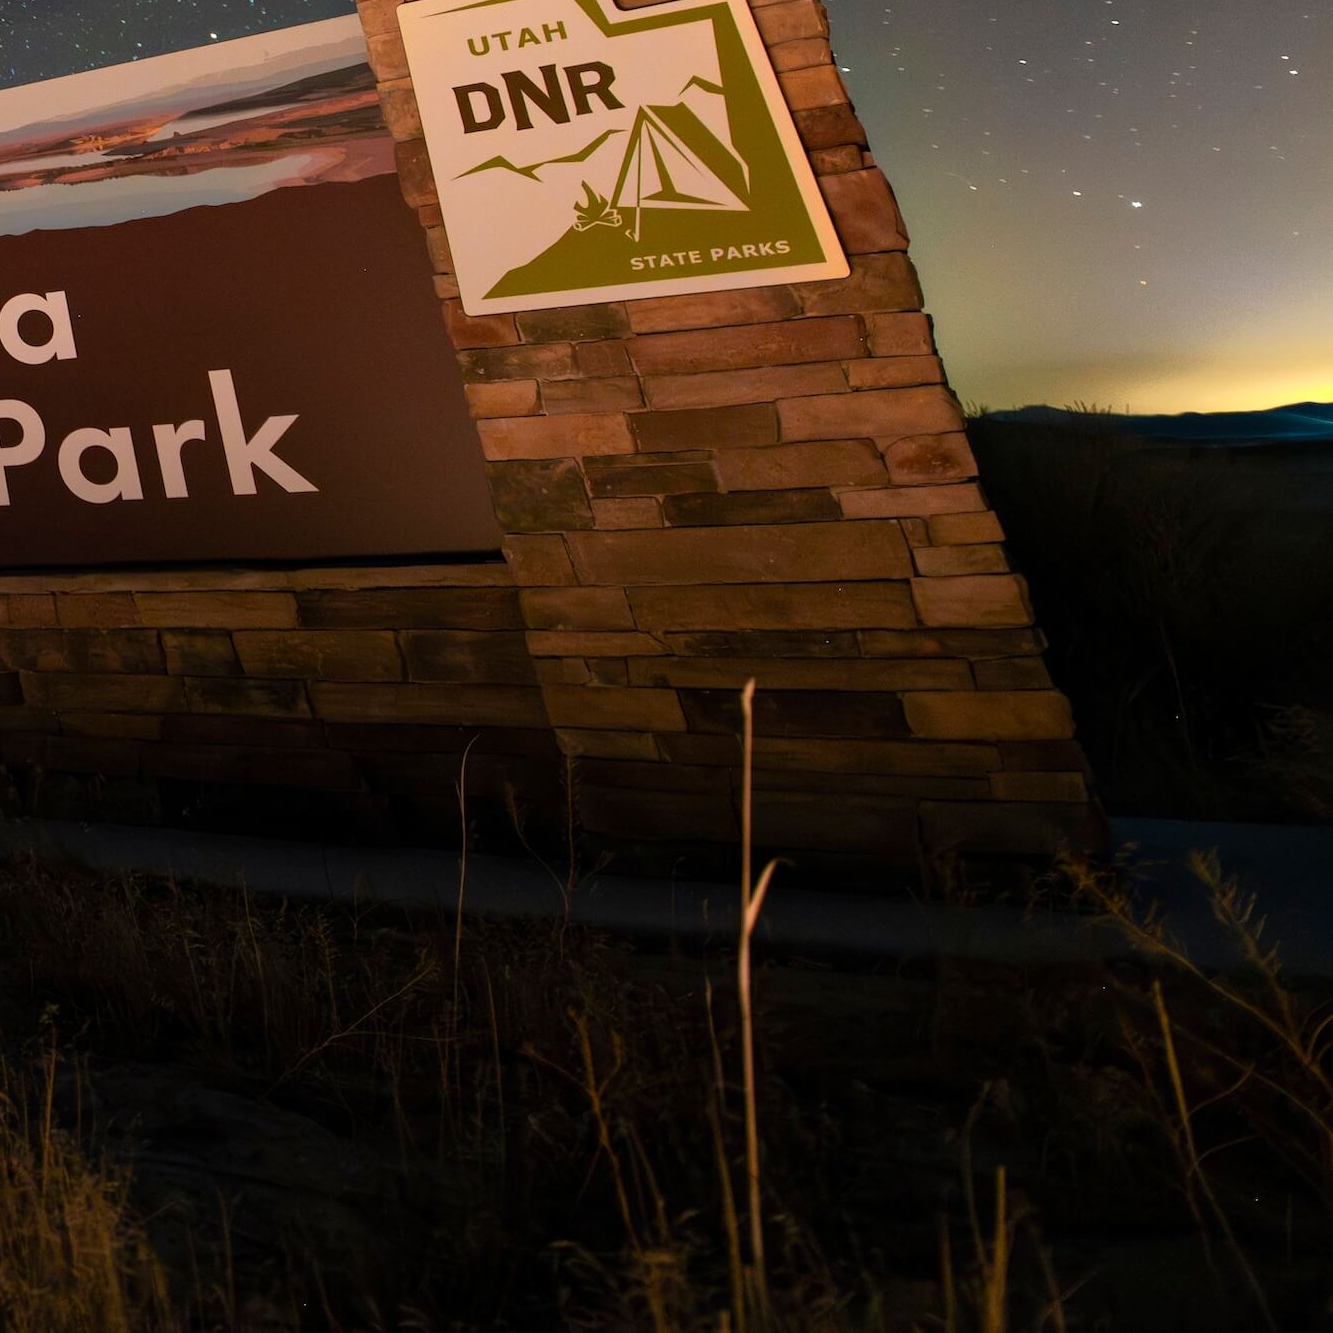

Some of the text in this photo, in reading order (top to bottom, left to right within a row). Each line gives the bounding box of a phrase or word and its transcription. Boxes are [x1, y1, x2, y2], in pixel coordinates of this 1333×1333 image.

[467, 21, 567, 56] UTAH
[452, 61, 625, 133] DNR
[630, 239, 791, 271] STATE PARKS
